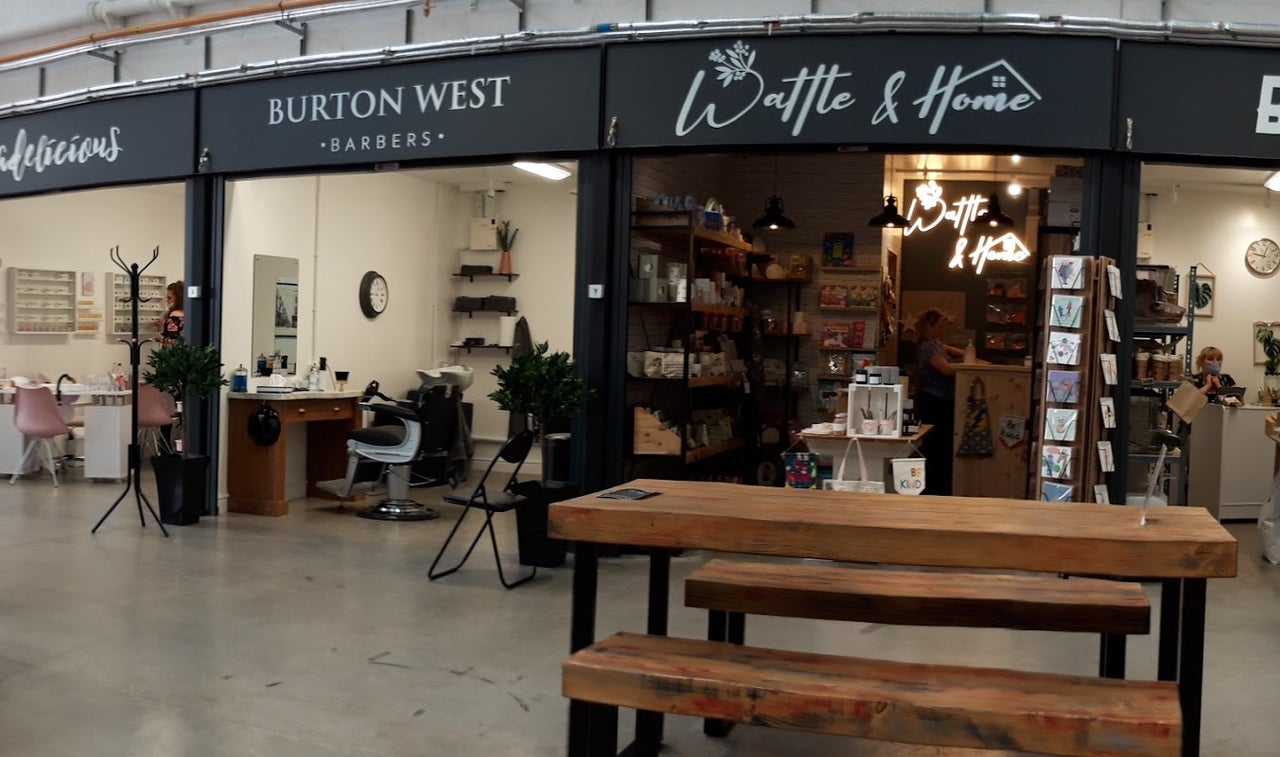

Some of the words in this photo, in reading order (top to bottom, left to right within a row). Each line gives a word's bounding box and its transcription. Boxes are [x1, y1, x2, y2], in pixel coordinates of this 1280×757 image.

[267, 86, 405, 125] BURTON
[412, 76, 511, 113] WEST
[675, 63, 856, 137] Wattle
[871, 70, 906, 125] &
[913, 62, 1039, 135] Home
[330, 131, 432, 152] BARBERS
